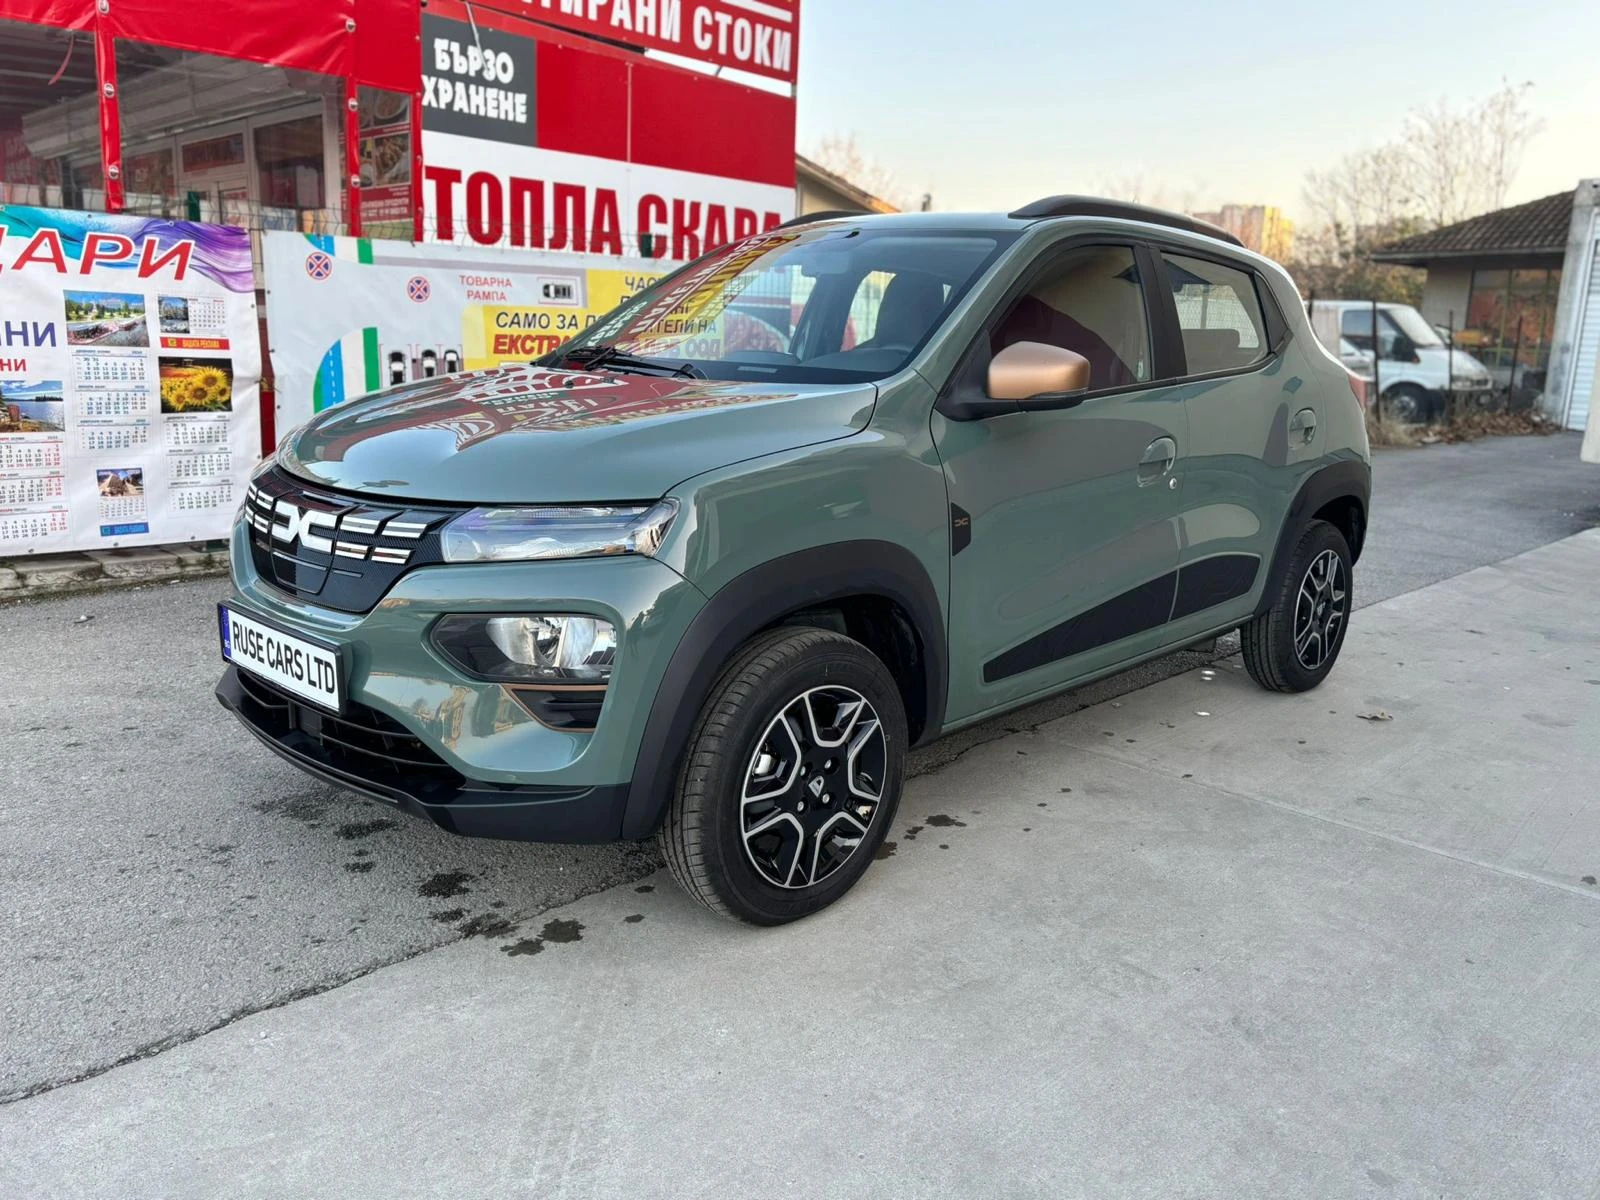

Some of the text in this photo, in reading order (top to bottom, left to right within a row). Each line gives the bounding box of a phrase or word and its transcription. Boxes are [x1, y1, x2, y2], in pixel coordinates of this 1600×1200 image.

[692, 6, 791, 73] СТОКИ
[434, 38, 514, 84] БЪРЗО
[422, 75, 528, 124] ХРАНЕНЕ
[424, 166, 782, 260] ТОПЛА СКАР
[0, 226, 193, 280] АРИ
[460, 276, 512, 288] ТОВАРНА
[467, 290, 508, 302] РАМПА
[625, 276, 662, 291] ЧАС
[0, 320, 57, 347] НИ
[496, 312, 550, 329] САМО
[556, 314, 578, 330] ЗА
[698, 320, 717, 334] НА
[494, 334, 569, 355] ЕКСТР
[232, 620, 335, 694] RUSE CARS LTD
